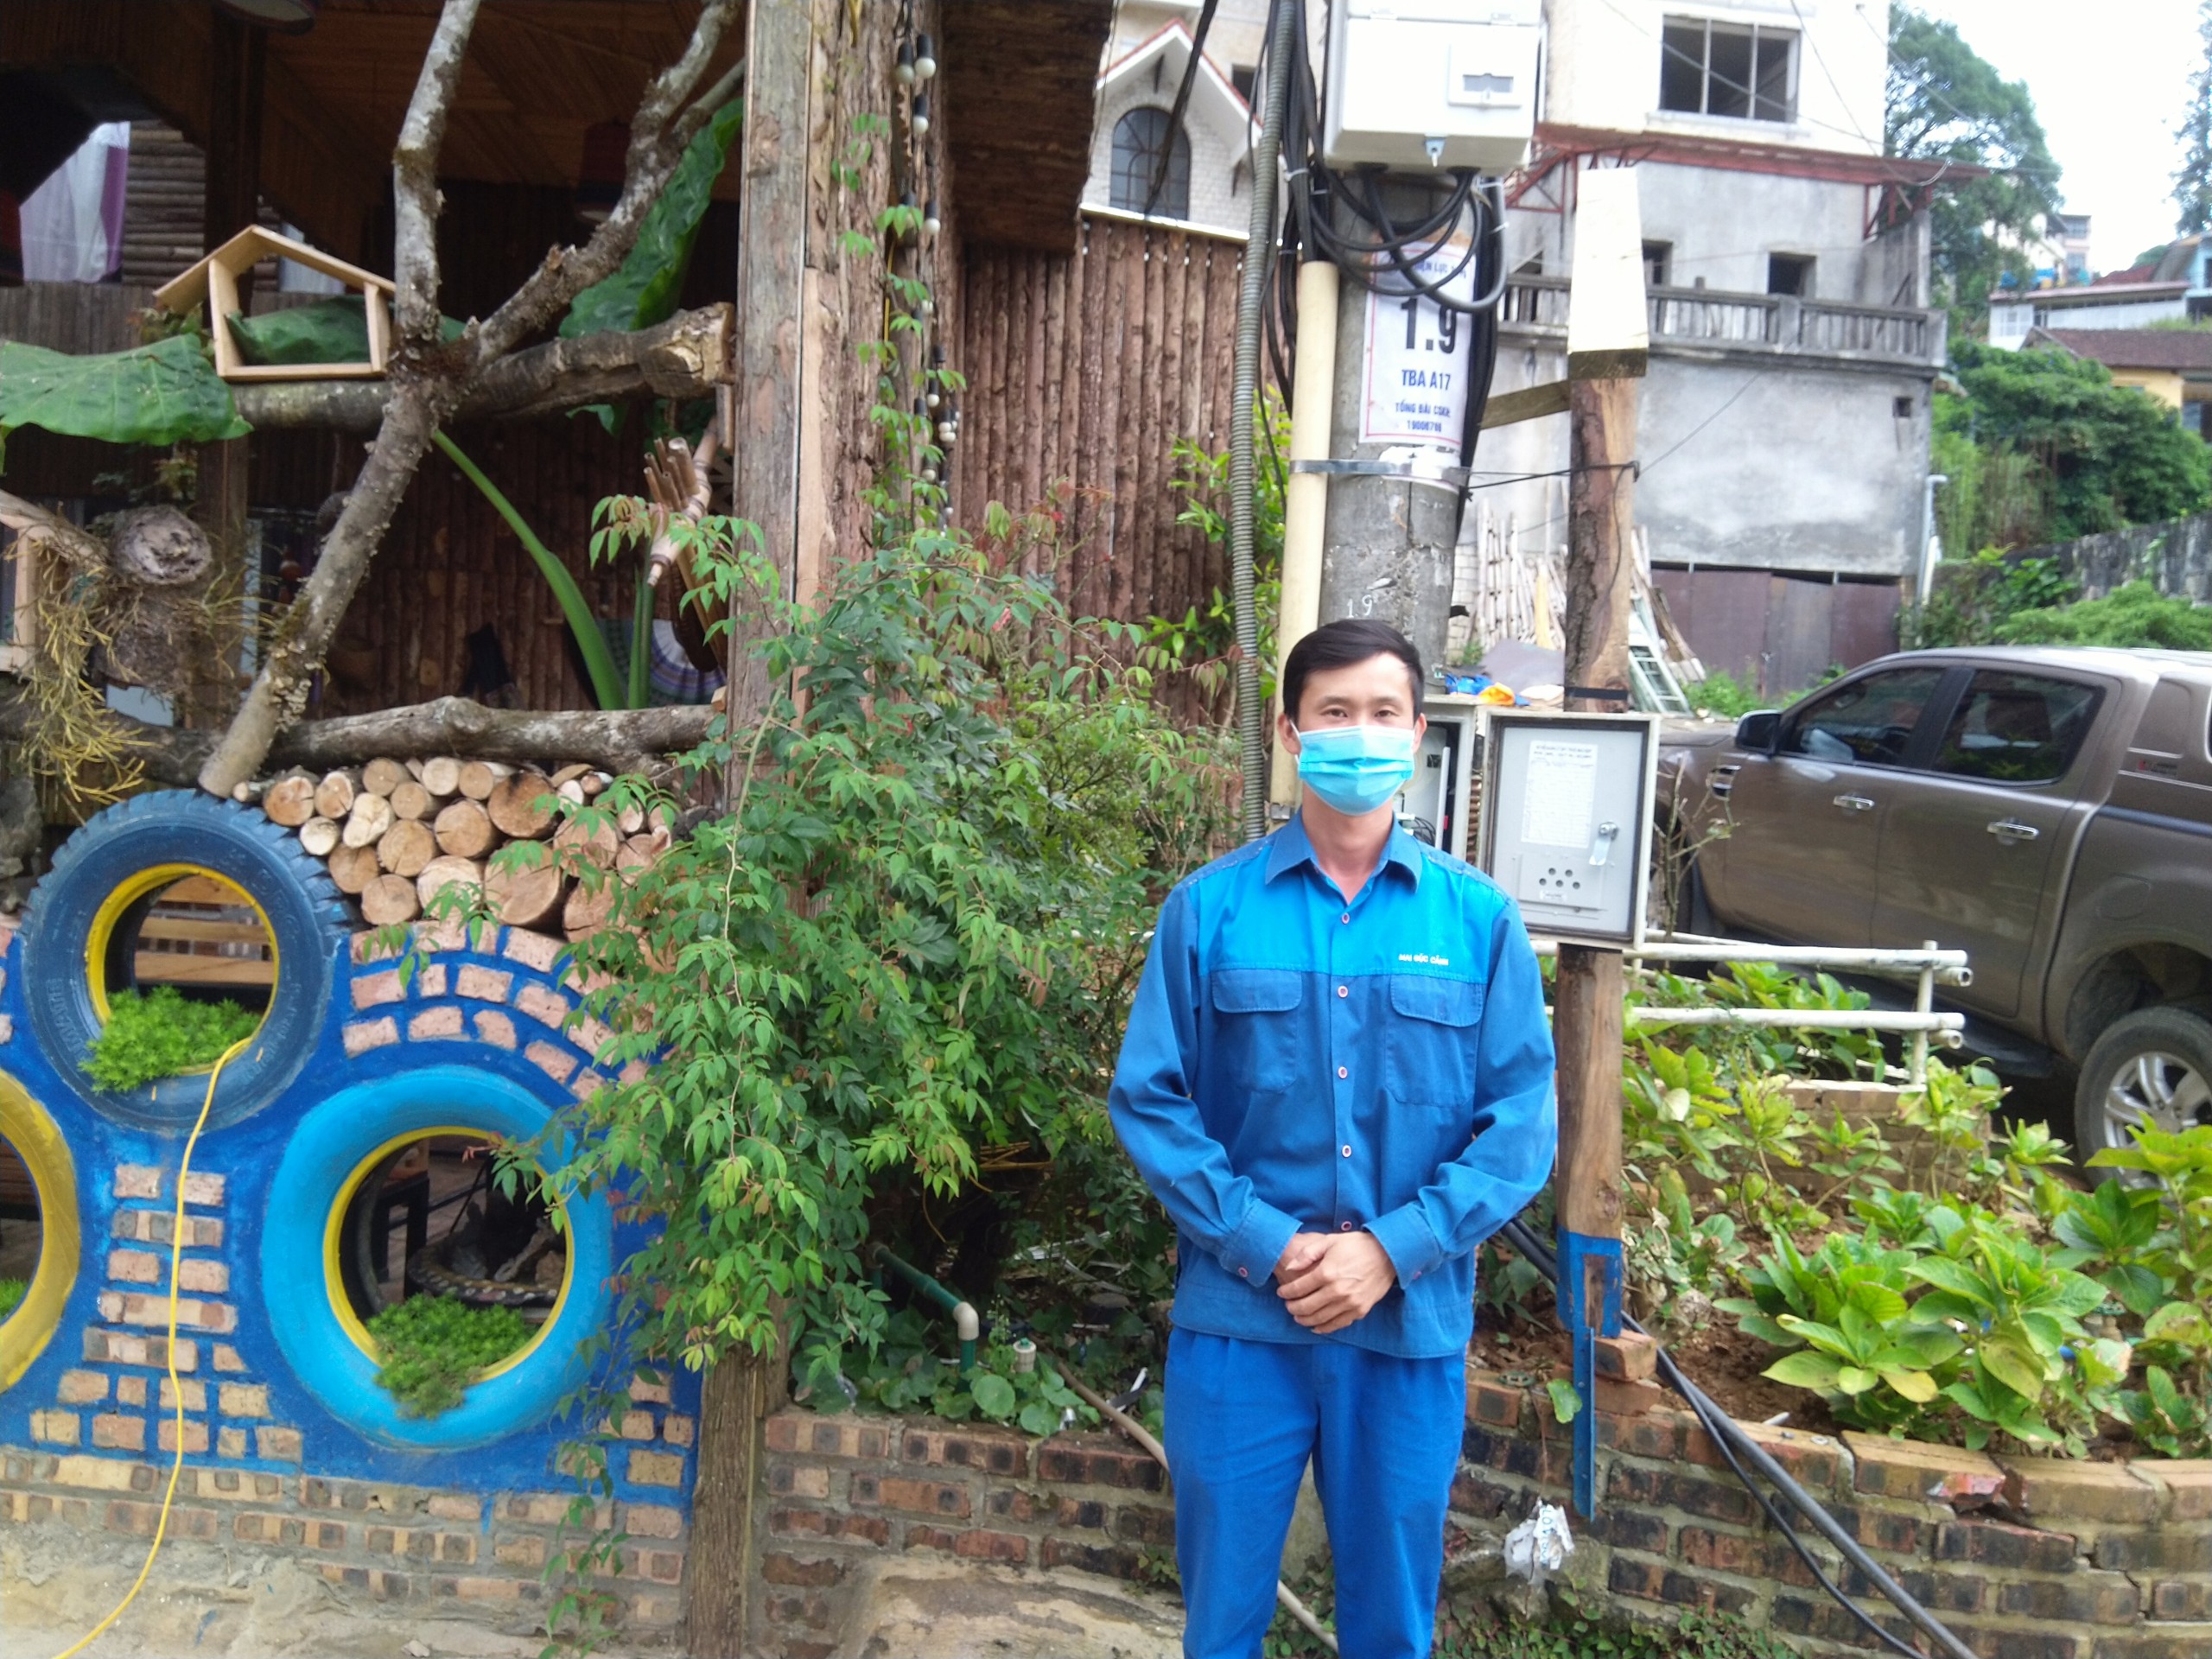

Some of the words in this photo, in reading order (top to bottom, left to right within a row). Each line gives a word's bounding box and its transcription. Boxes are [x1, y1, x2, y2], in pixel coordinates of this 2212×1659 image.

[1401, 297, 1457, 354] 1.9
[1402, 369, 1426, 387] TBA
[1429, 371, 1452, 391] A17
[1398, 953, 1413, 962] MAI
